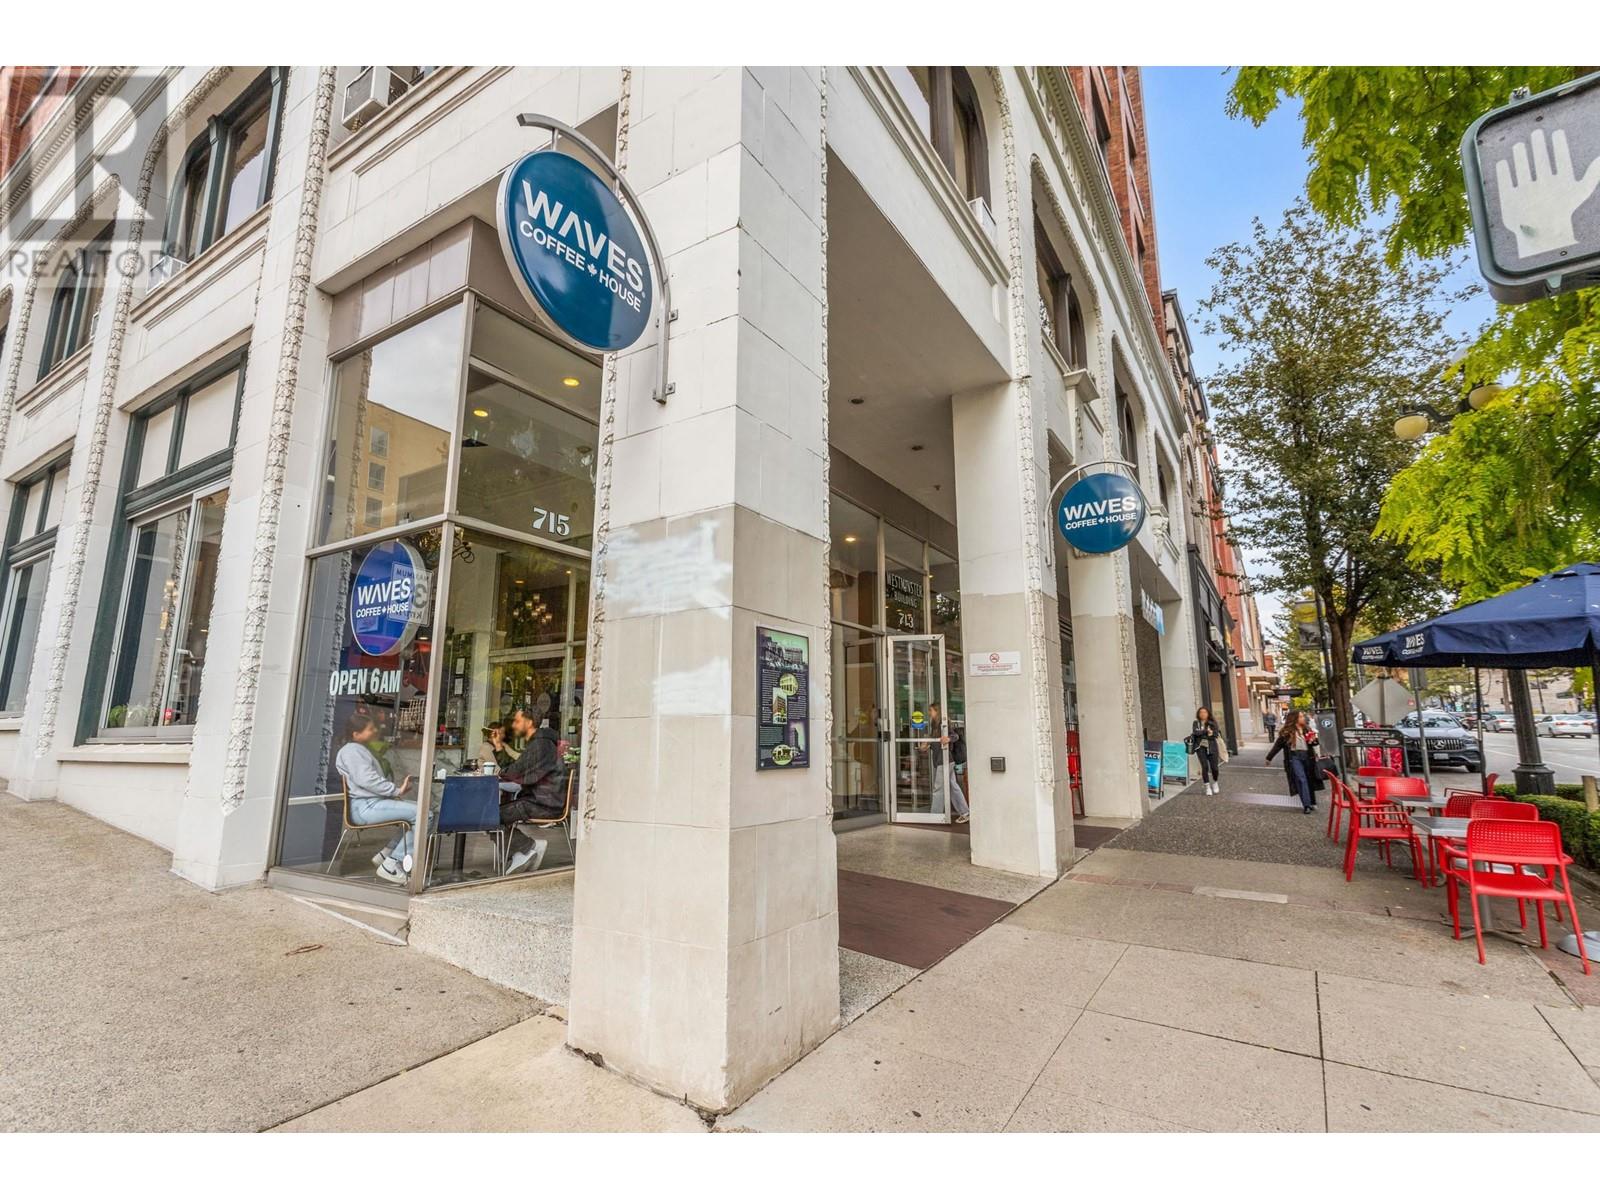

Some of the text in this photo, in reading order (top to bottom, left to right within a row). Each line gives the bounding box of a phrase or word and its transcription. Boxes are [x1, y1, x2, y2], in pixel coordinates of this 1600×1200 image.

[521, 179, 643, 293] WAVES
[519, 220, 642, 312] COFFEE HOUSE
[533, 506, 570, 536] 715
[1063, 496, 1137, 521] WAVES
[1065, 512, 1137, 530] COFFEE HOUSE
[357, 578, 411, 606] WAVES
[356, 602, 409, 618] COFFEE HOUSE
[898, 612, 914, 628] 713
[329, 667, 401, 696] OPEN 6AM
